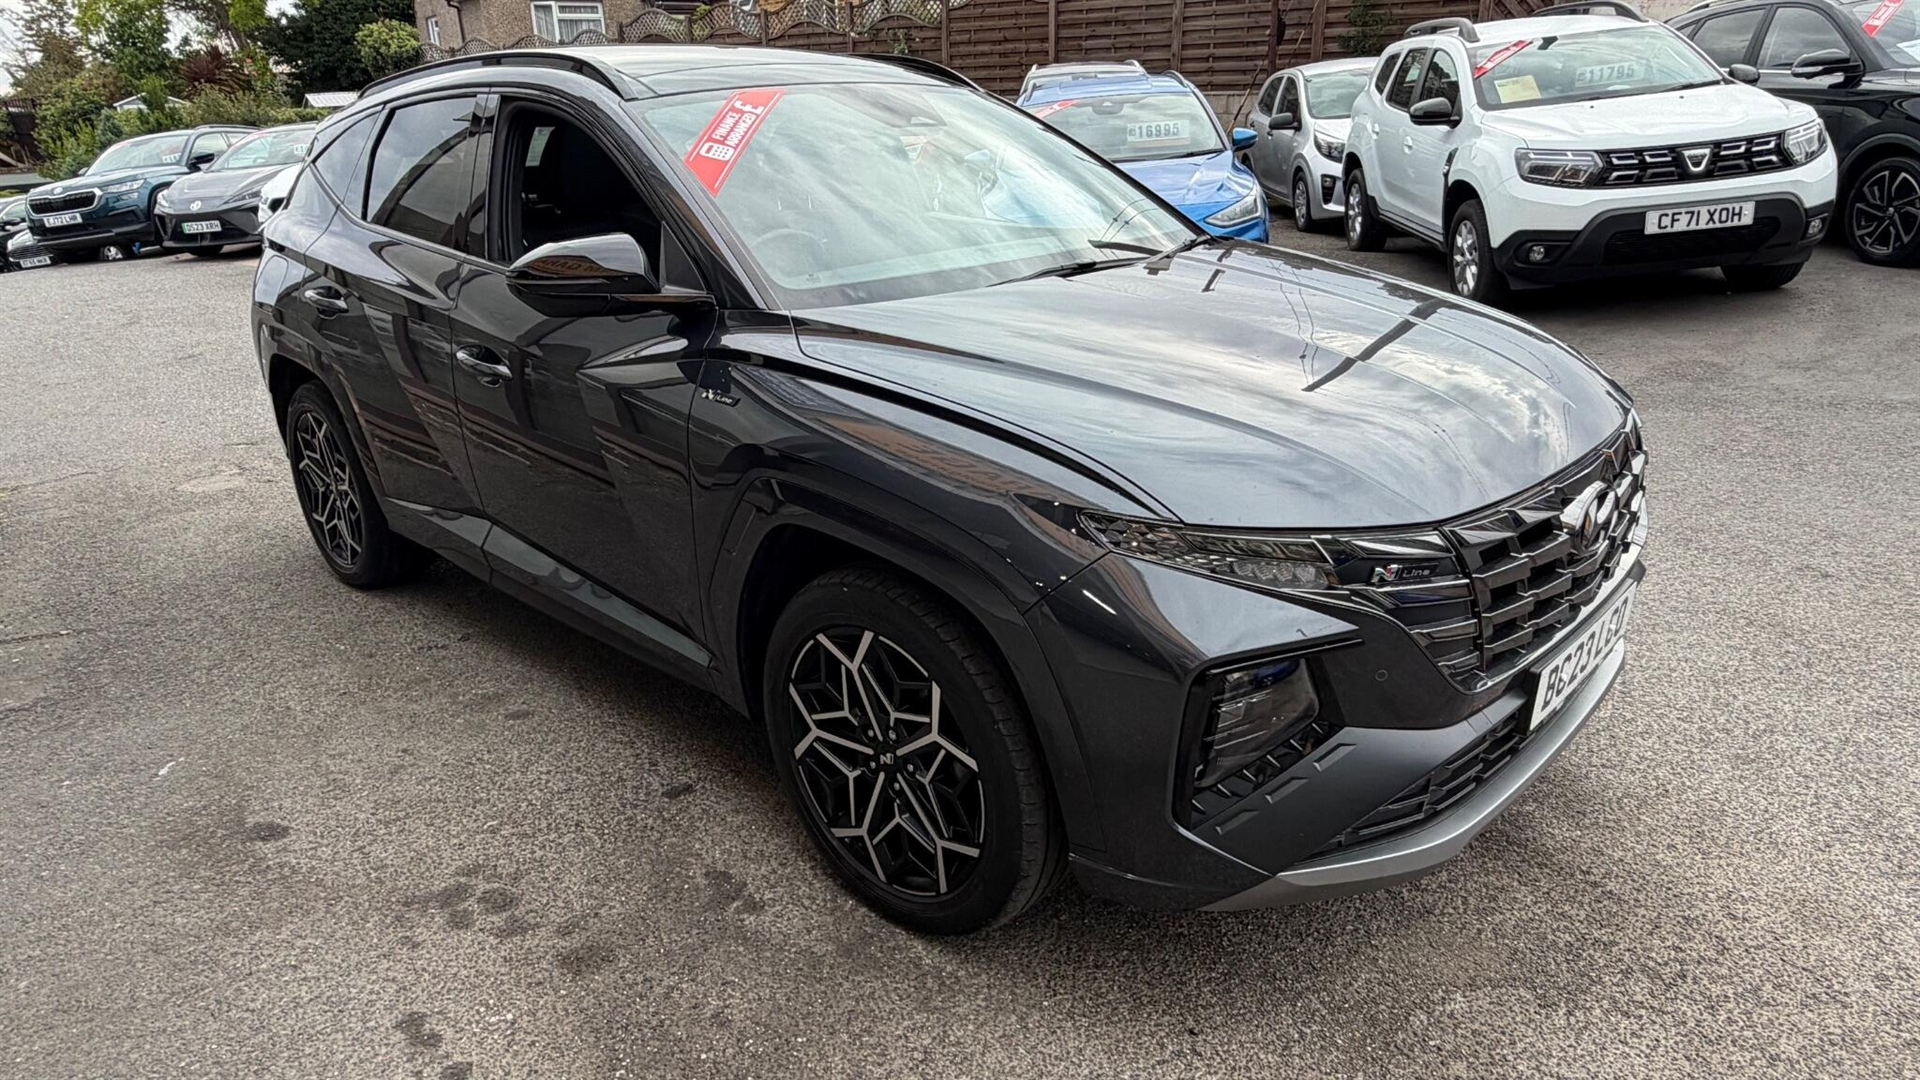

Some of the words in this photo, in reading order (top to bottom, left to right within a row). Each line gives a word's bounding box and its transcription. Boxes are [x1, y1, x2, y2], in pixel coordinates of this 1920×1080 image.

[711, 111, 742, 141] FINANCE
[724, 112, 757, 148] ARRANGED
[1657, 209, 1701, 230] CF71
[1705, 205, 1743, 226] XOH
